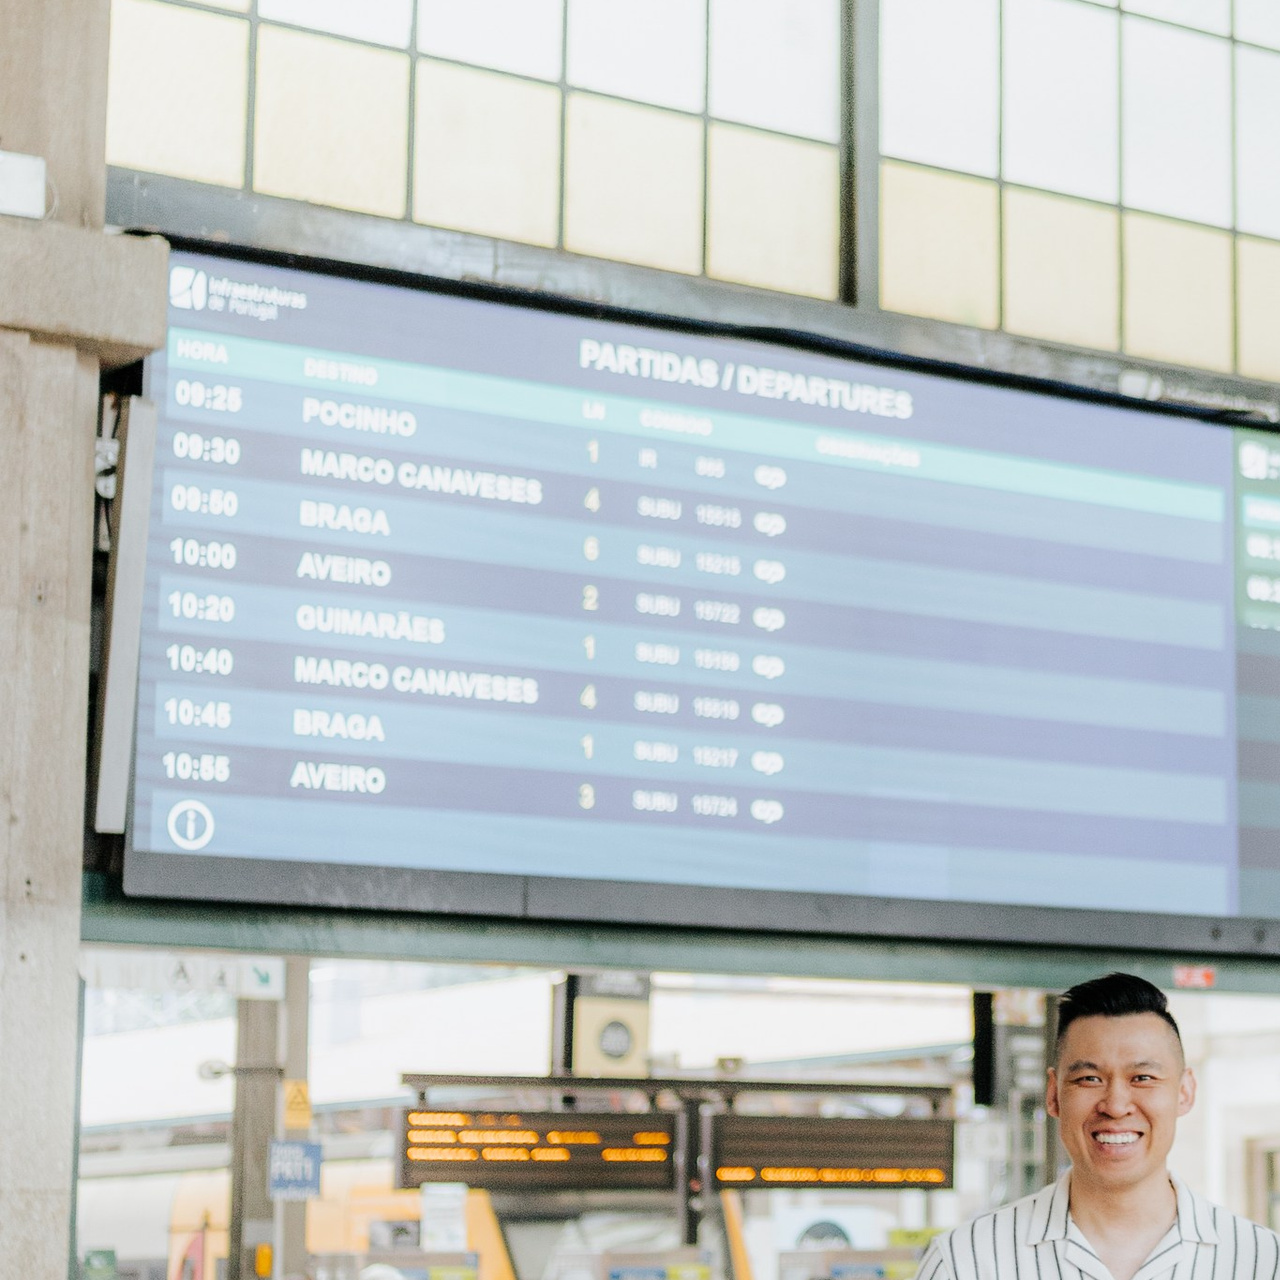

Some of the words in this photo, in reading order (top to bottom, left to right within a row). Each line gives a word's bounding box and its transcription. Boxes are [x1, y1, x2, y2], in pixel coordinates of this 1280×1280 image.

[177, 338, 229, 364] HORA
[304, 357, 378, 387] DESTINO
[579, 339, 720, 389] PARTIDAS
[721, 363, 735, 392] /
[737, 365, 914, 419] DEPARTURES
[175, 379, 242, 413] 09:25
[302, 397, 417, 437] POCINHO
[586, 439, 599, 464] 1
[173, 431, 240, 465] 09:30
[301, 448, 395, 485] MARCO
[397, 462, 543, 505] CANAVESES
[584, 487, 601, 512] 4
[171, 484, 238, 516] 09:50
[300, 499, 390, 536] BRAGA
[170, 538, 237, 570] 10:00
[296, 552, 392, 587] AVEIRO
[583, 584, 599, 611] 2
[168, 591, 235, 623] 10:20
[296, 604, 445, 644] GUIMARÃES
[582, 634, 595, 661] 1
[166, 644, 234, 676] 10:40
[294, 655, 389, 690] MARCO
[392, 666, 539, 704] CANAVESES
[580, 684, 597, 710] 4
[164, 698, 232, 729] 10:45
[293, 708, 385, 742] BRAGA
[580, 733, 594, 760] 1
[162, 751, 230, 783] 10:55
[290, 761, 386, 794] AVEIRO
[578, 783, 595, 810] 3
